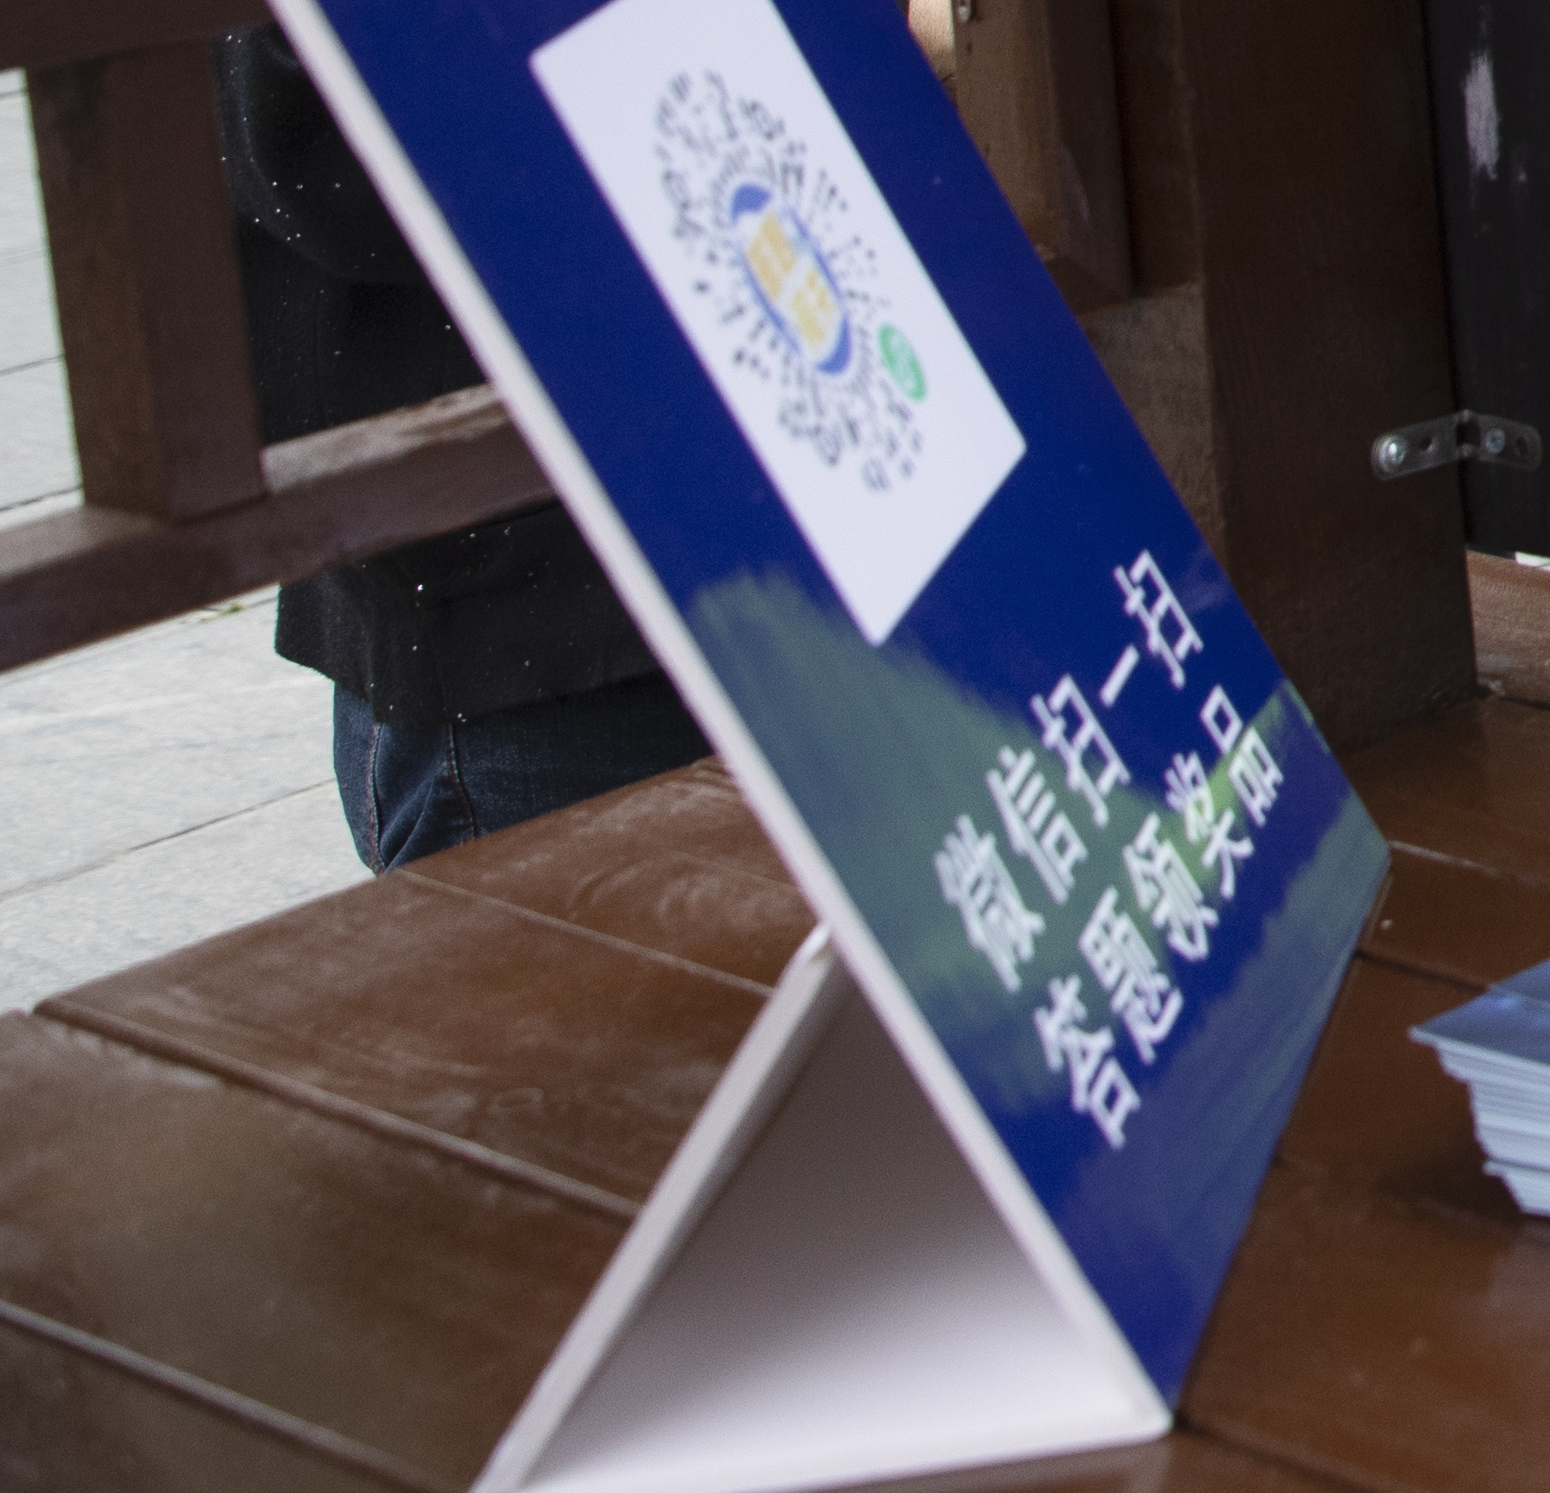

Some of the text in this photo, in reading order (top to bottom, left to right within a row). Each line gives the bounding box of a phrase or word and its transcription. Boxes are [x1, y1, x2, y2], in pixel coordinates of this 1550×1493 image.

[936, 550, 1205, 988] 微信扫一扫
[1034, 683, 1289, 1148] 答题领奖品
